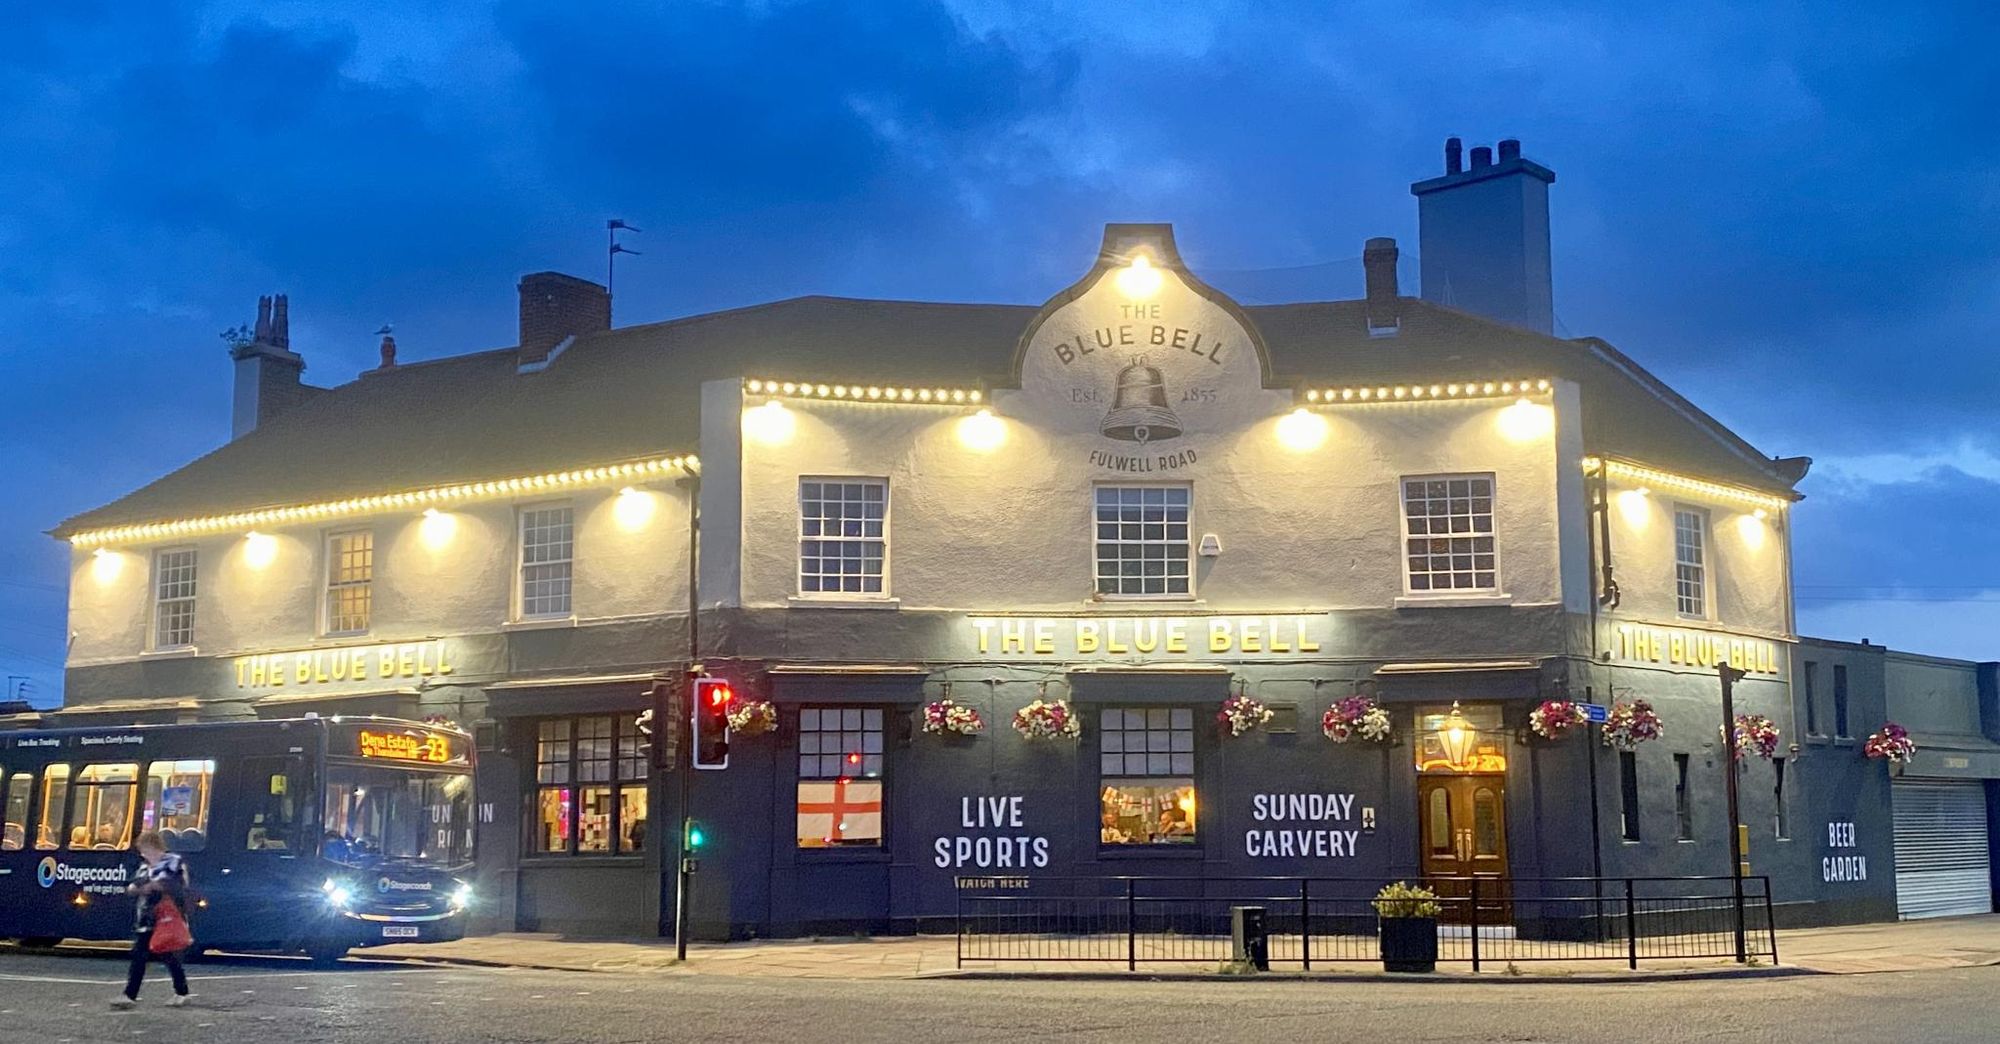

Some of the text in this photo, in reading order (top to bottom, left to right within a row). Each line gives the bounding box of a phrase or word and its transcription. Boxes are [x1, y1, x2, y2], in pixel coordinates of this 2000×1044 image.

[1120, 304, 1161, 319] THE
[1054, 325, 1222, 366] BLUE BELL
[1072, 387, 1217, 403] Est. 1855
[1089, 449, 1198, 472] FULWELL ROAD
[972, 617, 1321, 654] THE BLUE BELL
[1618, 624, 1779, 674] THE BLUE BELL
[234, 640, 454, 688] THE BLUE BELL
[361, 732, 417, 750] Dene Estate
[426, 738, 449, 761] 23
[962, 796, 1023, 828] LIVE
[1253, 794, 1355, 821] SUNDAY
[1245, 829, 1359, 857] CARVERY
[1828, 822, 1856, 847] BEER
[934, 837, 1049, 868] SPORTS
[56, 863, 127, 885] Stagecoach
[1822, 856, 1867, 882] GARDEN
[390, 881, 432, 891] Stagecoach
